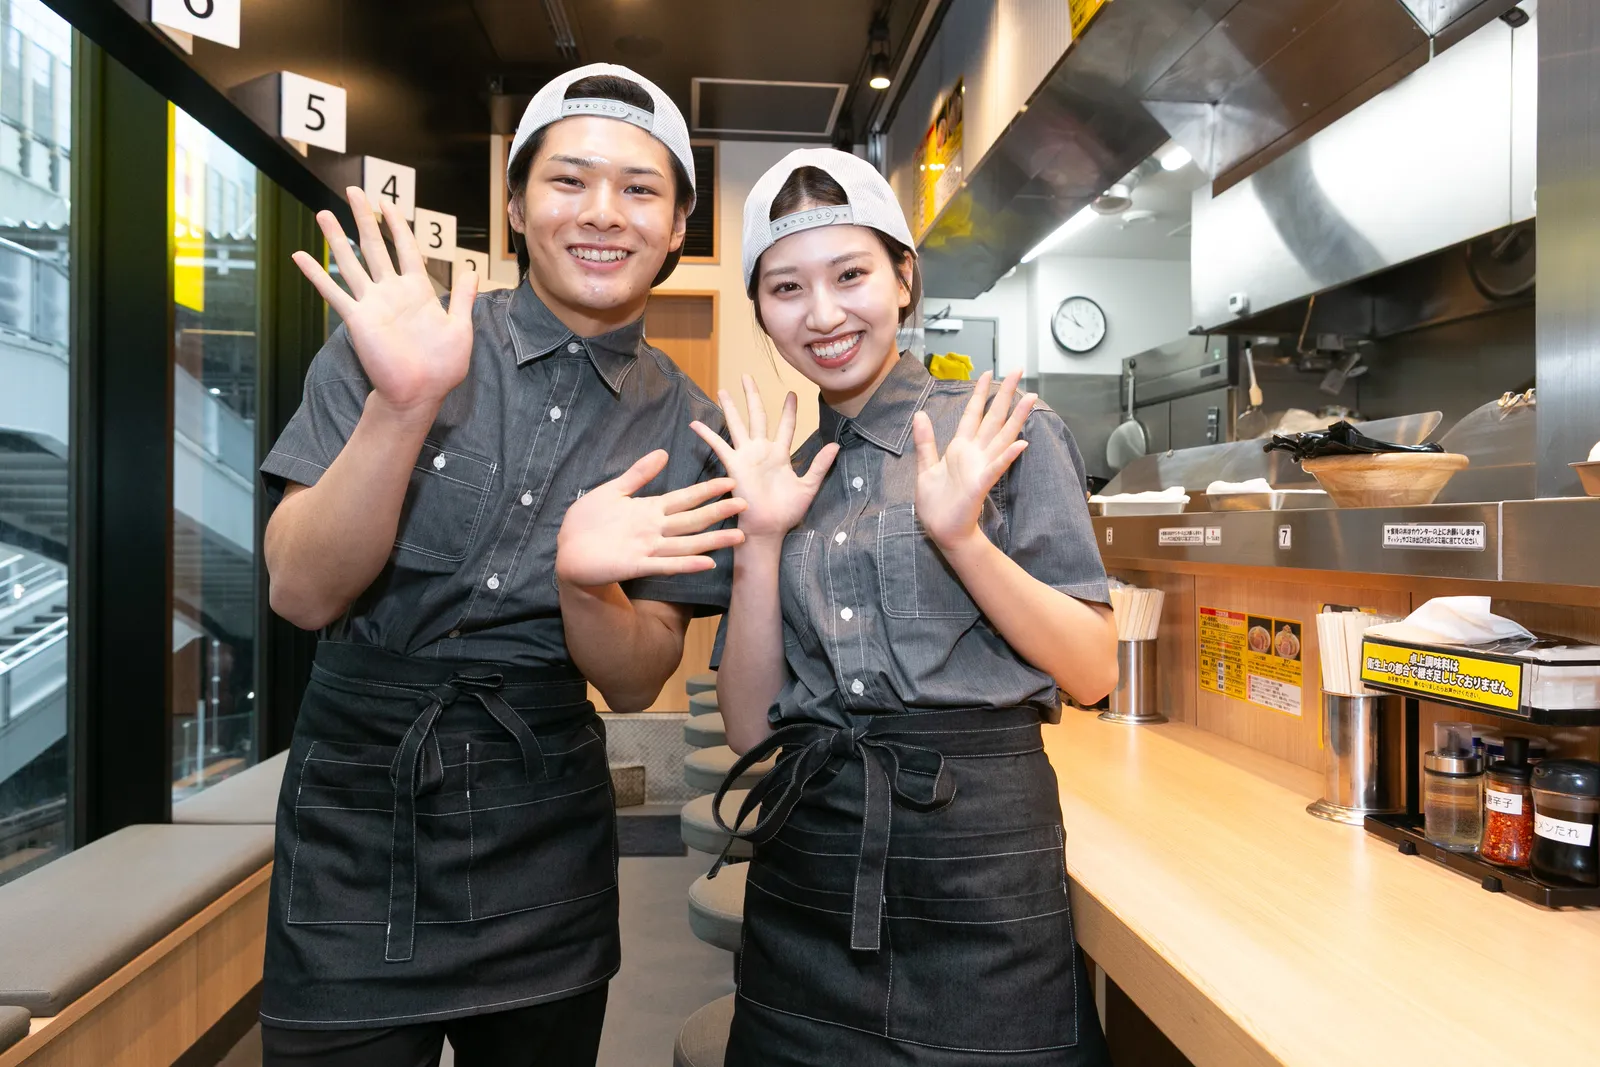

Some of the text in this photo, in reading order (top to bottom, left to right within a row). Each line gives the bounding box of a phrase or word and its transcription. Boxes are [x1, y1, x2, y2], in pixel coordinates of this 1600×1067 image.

[305, 93, 326, 131] 5
[381, 175, 400, 205] 4
[429, 222, 443, 249] 3
[1282, 530, 1288, 545] 7
[1366, 656, 1514, 697] 衛生上の都合で継ぎ足ししておりません。
[1409, 652, 1459, 673] 卓上調味料は
